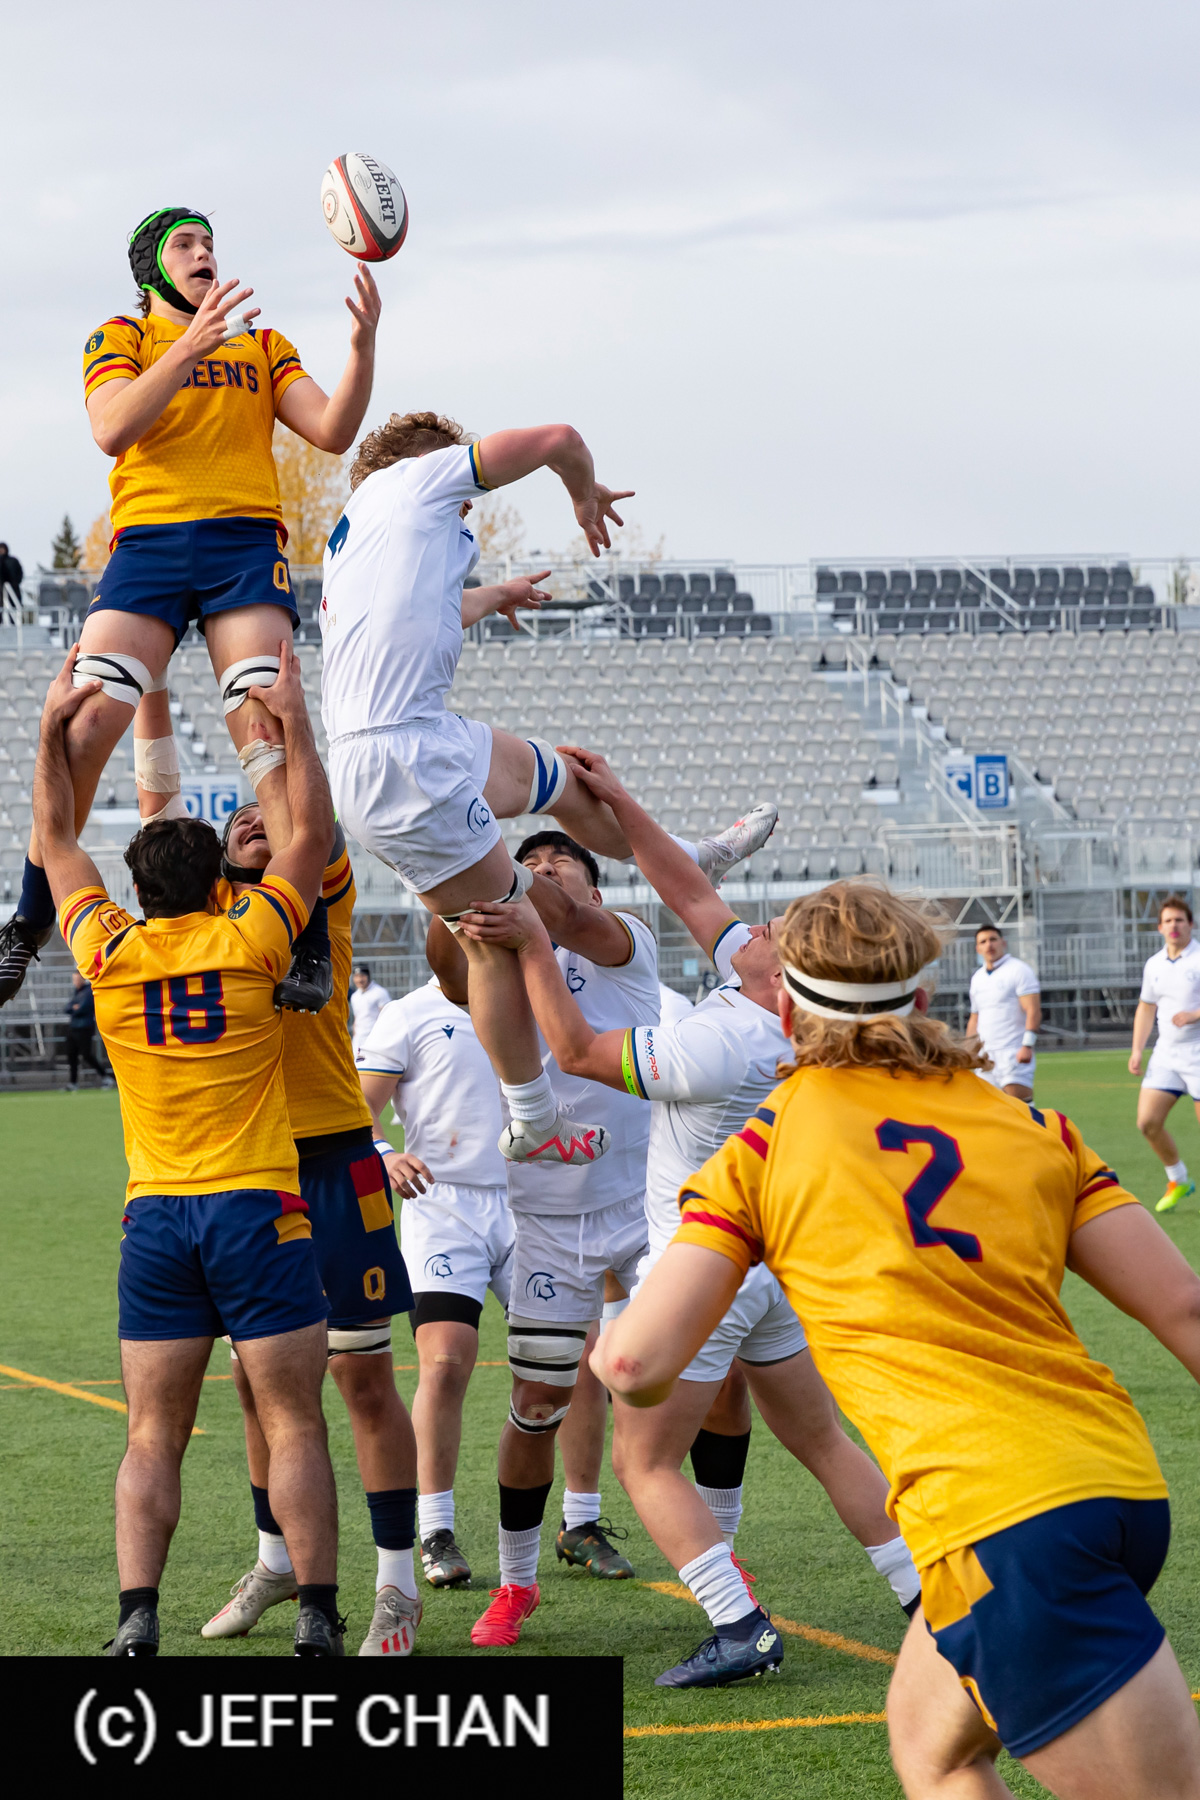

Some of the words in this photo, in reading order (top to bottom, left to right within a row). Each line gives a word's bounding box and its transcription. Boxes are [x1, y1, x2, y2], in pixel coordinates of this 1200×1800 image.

[355, 152, 397, 225] GILBERT
[90, 337, 97, 352] 6
[273, 560, 290, 594] Q
[985, 773, 1000, 796] B
[214, 794, 234, 819] C
[142, 970, 227, 1046] 18
[874, 1117, 983, 1263] 2
[363, 1266, 386, 1301] Q
